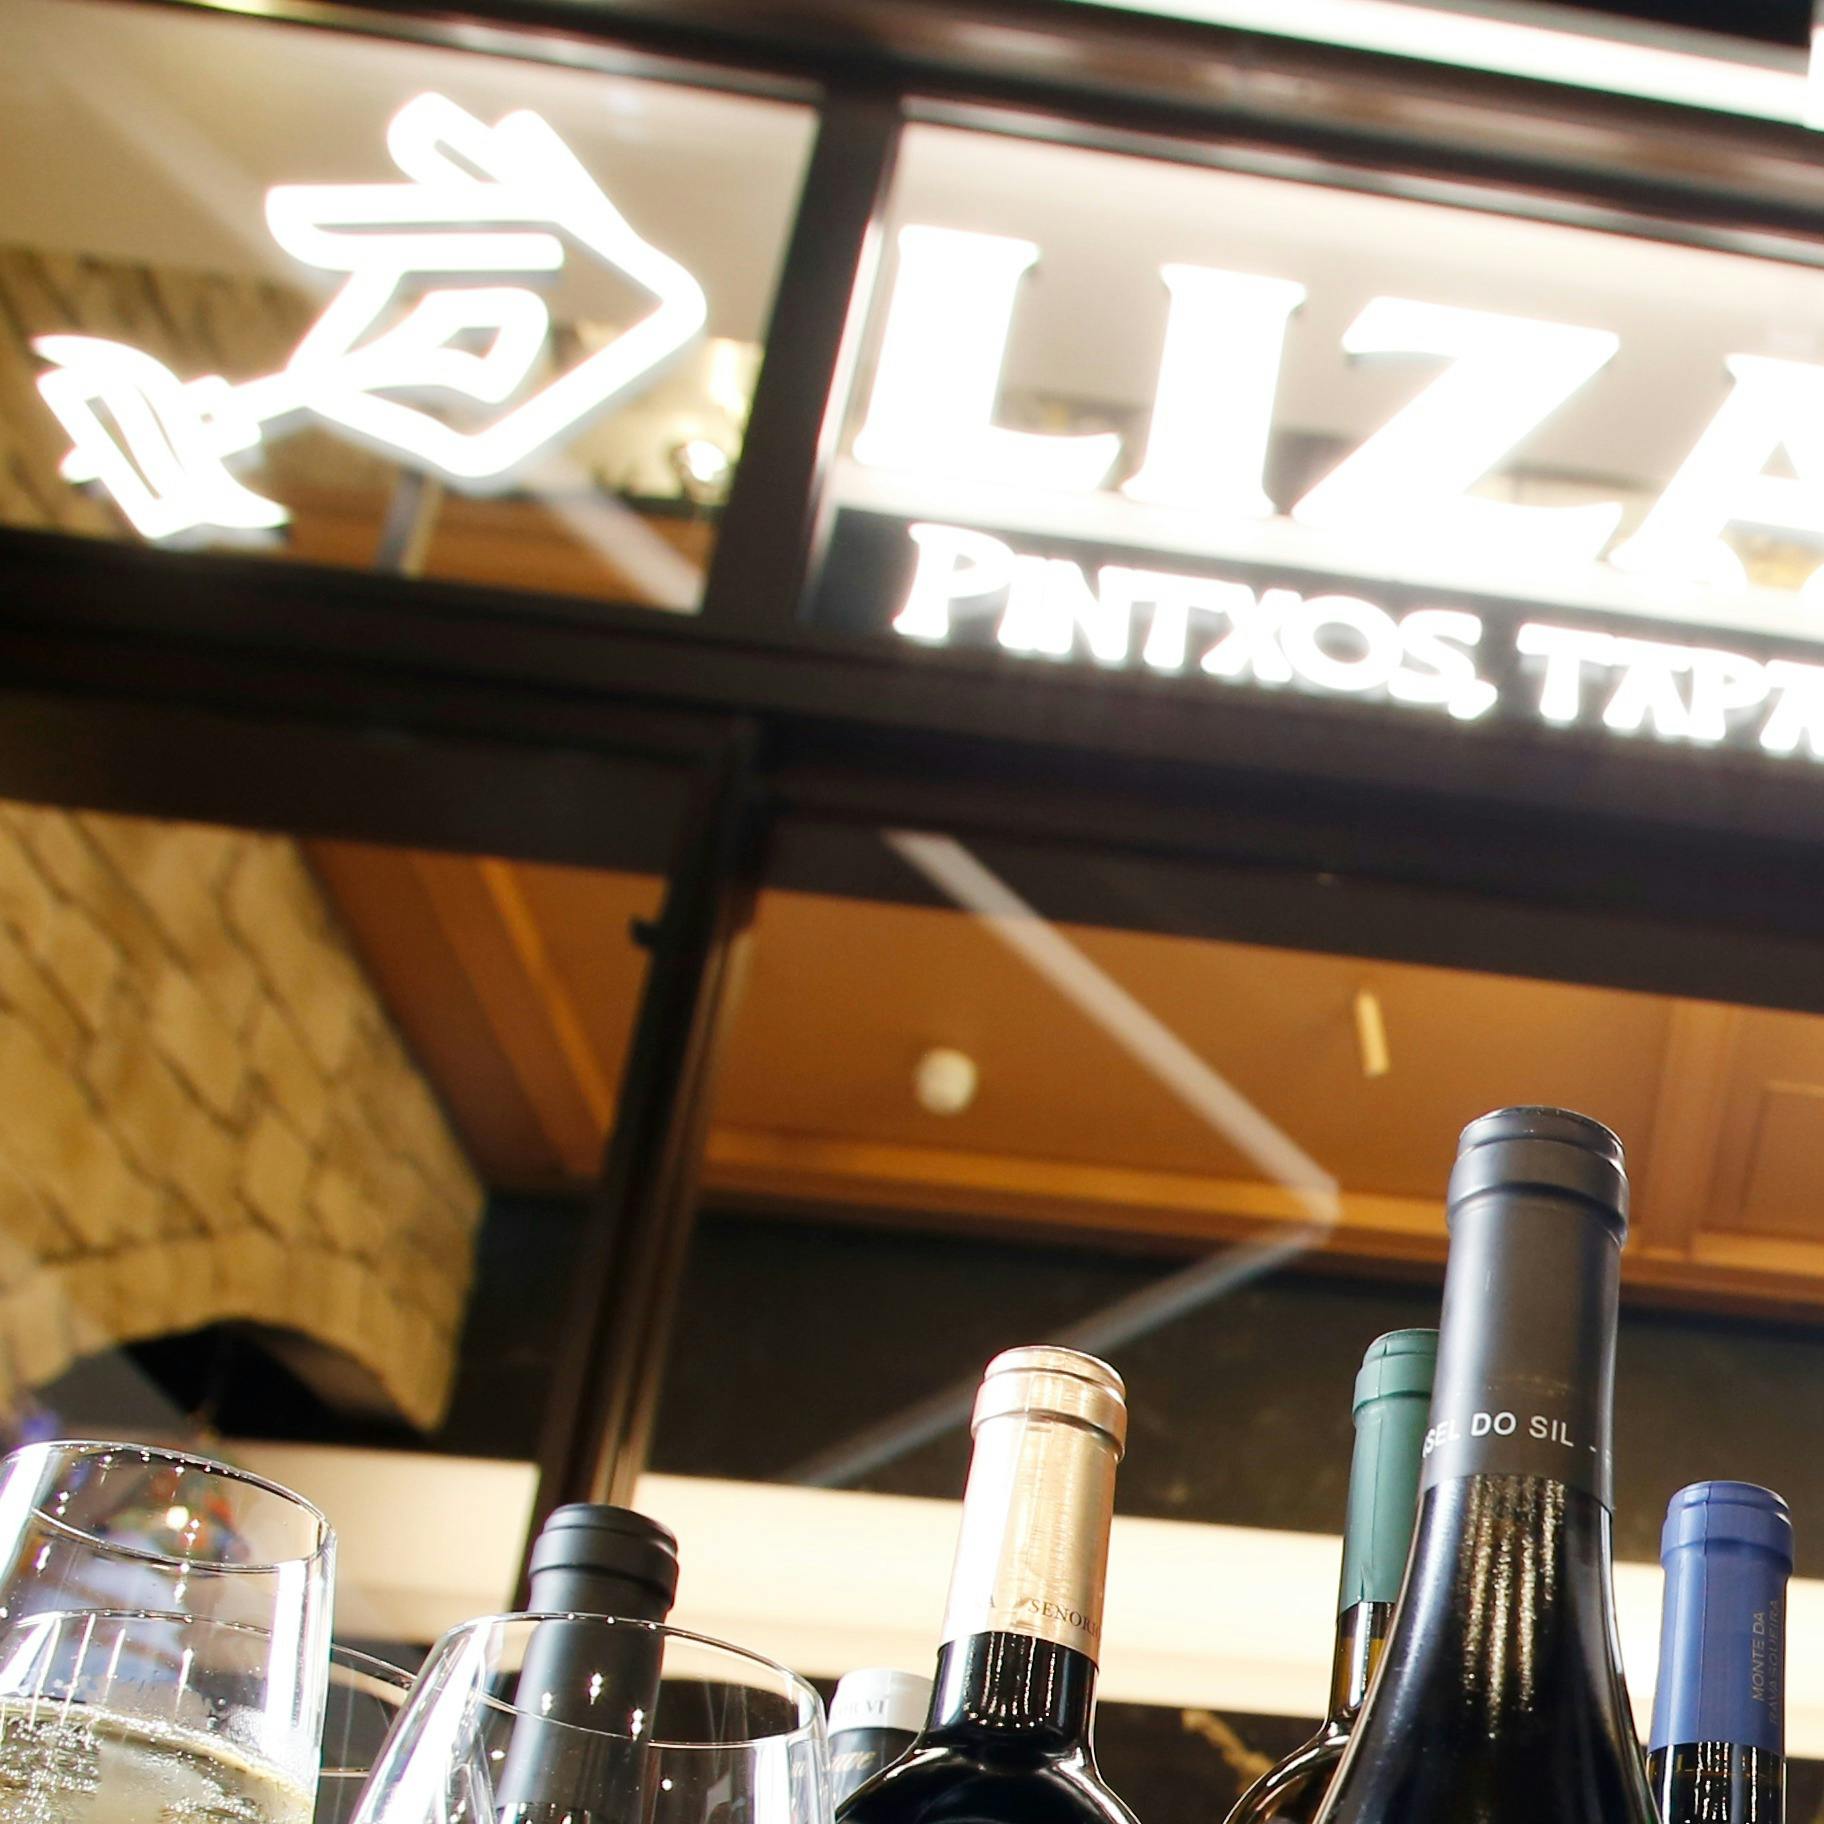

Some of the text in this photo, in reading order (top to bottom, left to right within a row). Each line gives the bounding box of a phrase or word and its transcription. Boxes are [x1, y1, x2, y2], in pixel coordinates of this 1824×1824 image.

[893, 521, 1498, 721] PINTXOS,
[1470, 1411, 1517, 1437] DO
[1528, 1415, 1575, 1448] SIL
[1751, 1611, 1766, 1702] MONTE DA
